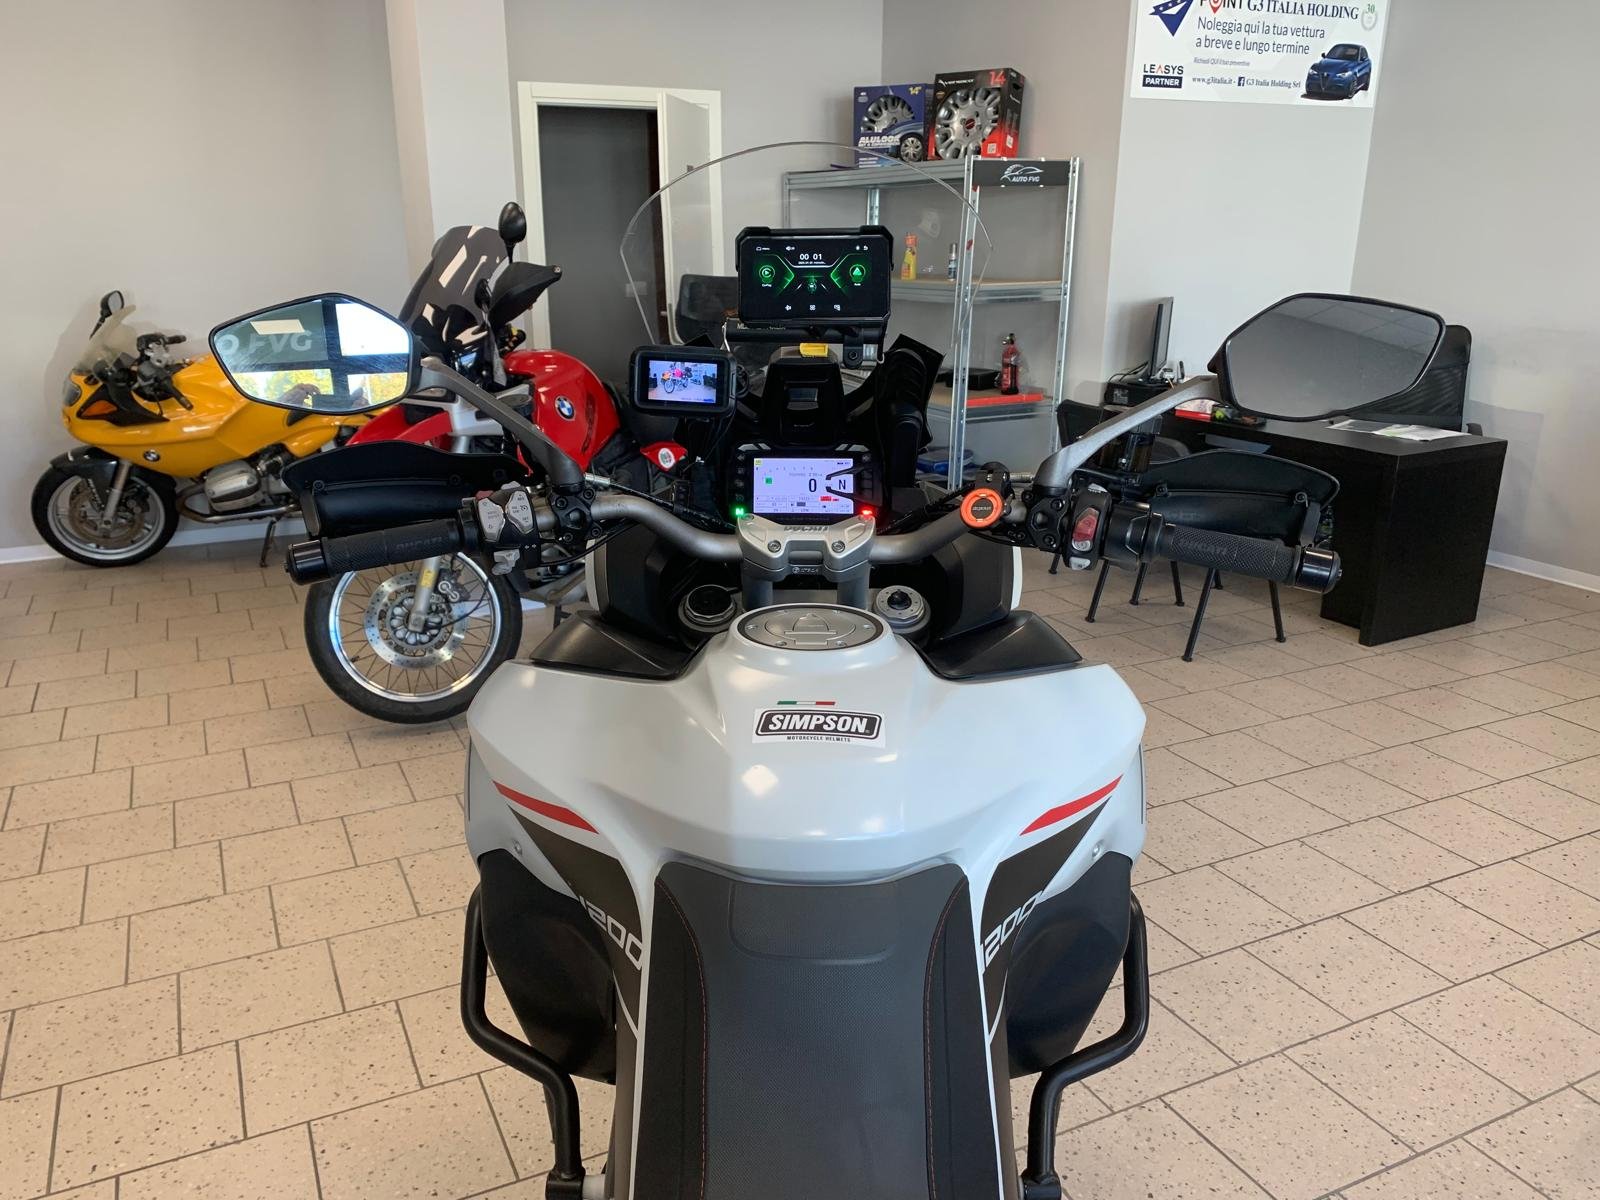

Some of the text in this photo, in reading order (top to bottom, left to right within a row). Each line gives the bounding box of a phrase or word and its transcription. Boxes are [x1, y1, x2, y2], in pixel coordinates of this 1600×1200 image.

[1247, 0, 1264, 11] G3
[1266, 0, 1304, 15] ITALIA
[1306, 3, 1360, 20] HOLDING
[1197, 16, 1325, 38] Noleggia qui la tua vettura
[1195, 35, 1310, 55] a breve e lungo termine
[1143, 64, 1184, 75] LEASYS
[989, 70, 1006, 86] 14
[1145, 77, 1180, 86] PARTNER
[1246, 78, 1254, 86] G3
[1255, 79, 1269, 87] Italia
[1270, 80, 1291, 89] Holding
[808, 478, 846, 492] 0 N
[768, 714, 868, 733] SIMPSON
